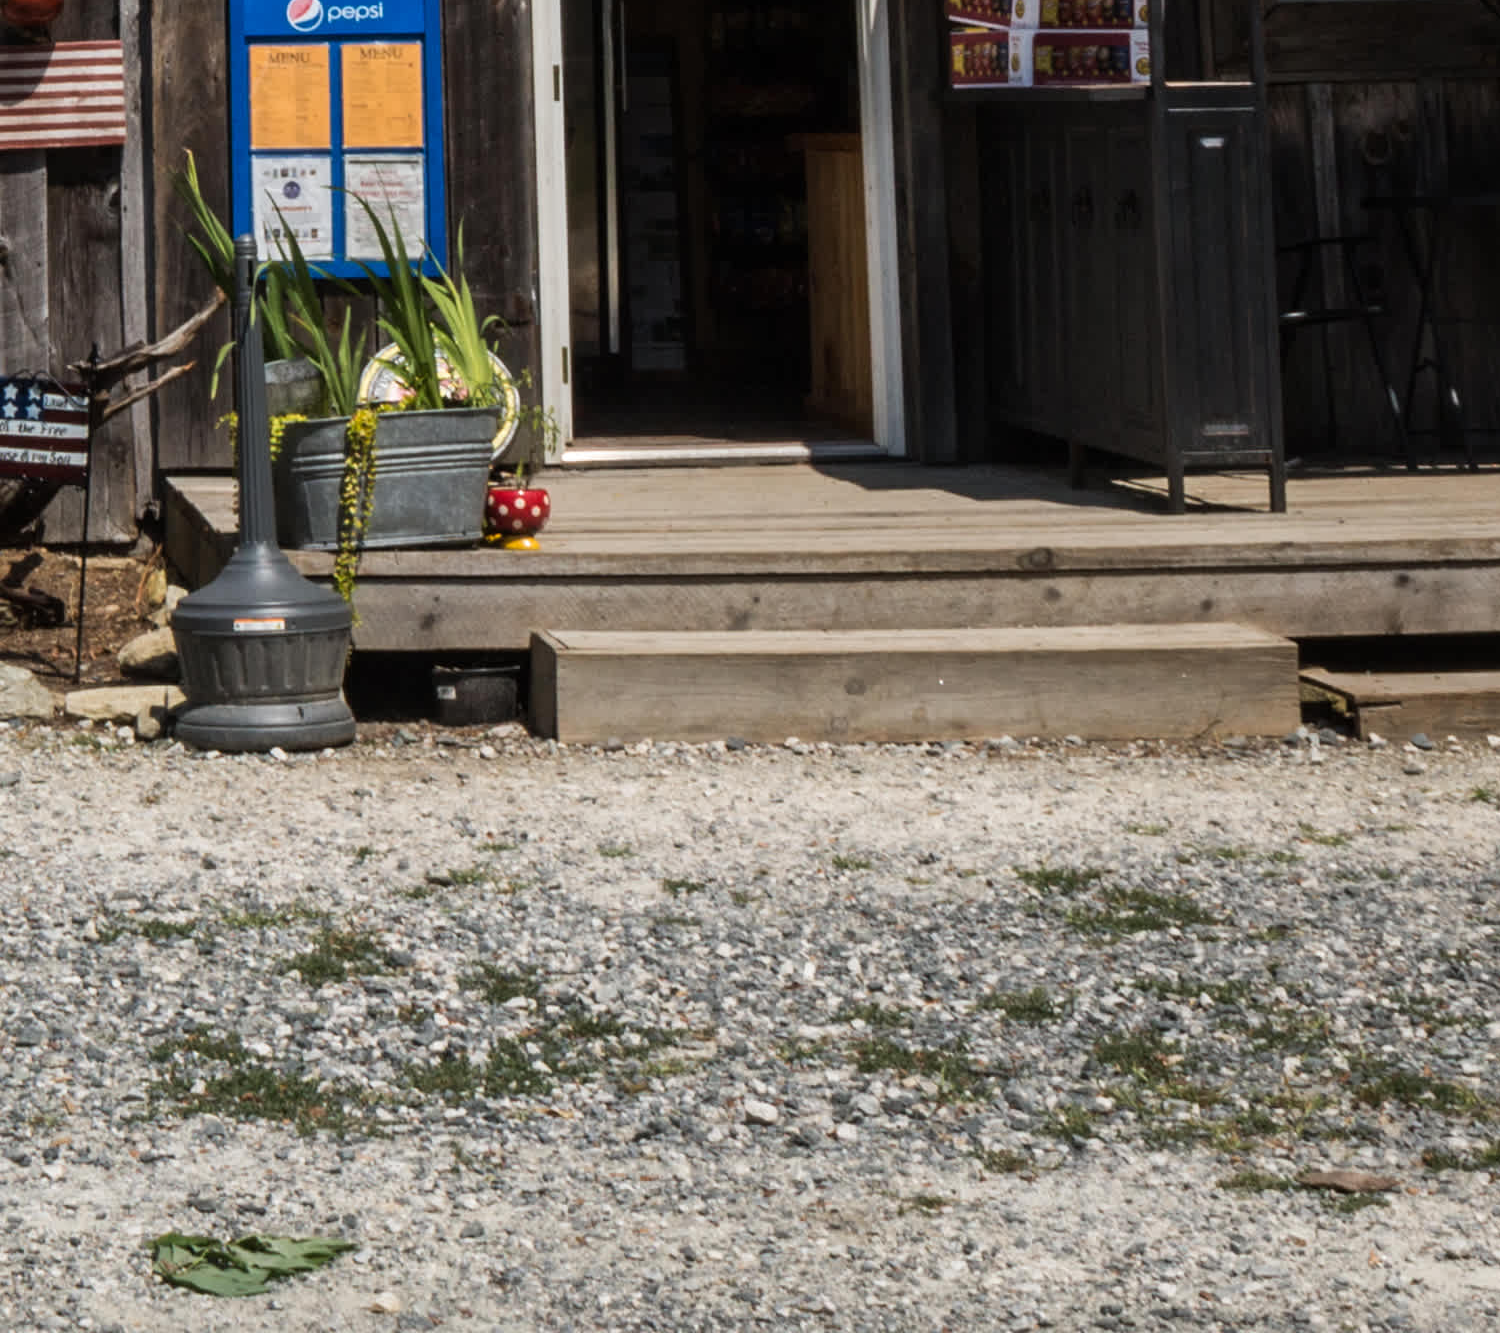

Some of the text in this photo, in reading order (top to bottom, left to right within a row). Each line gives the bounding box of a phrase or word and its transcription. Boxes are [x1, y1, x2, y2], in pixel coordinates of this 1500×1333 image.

[328, 2, 384, 23] pepsi
[268, 52, 312, 64] MENU
[359, 47, 404, 60] MENU
